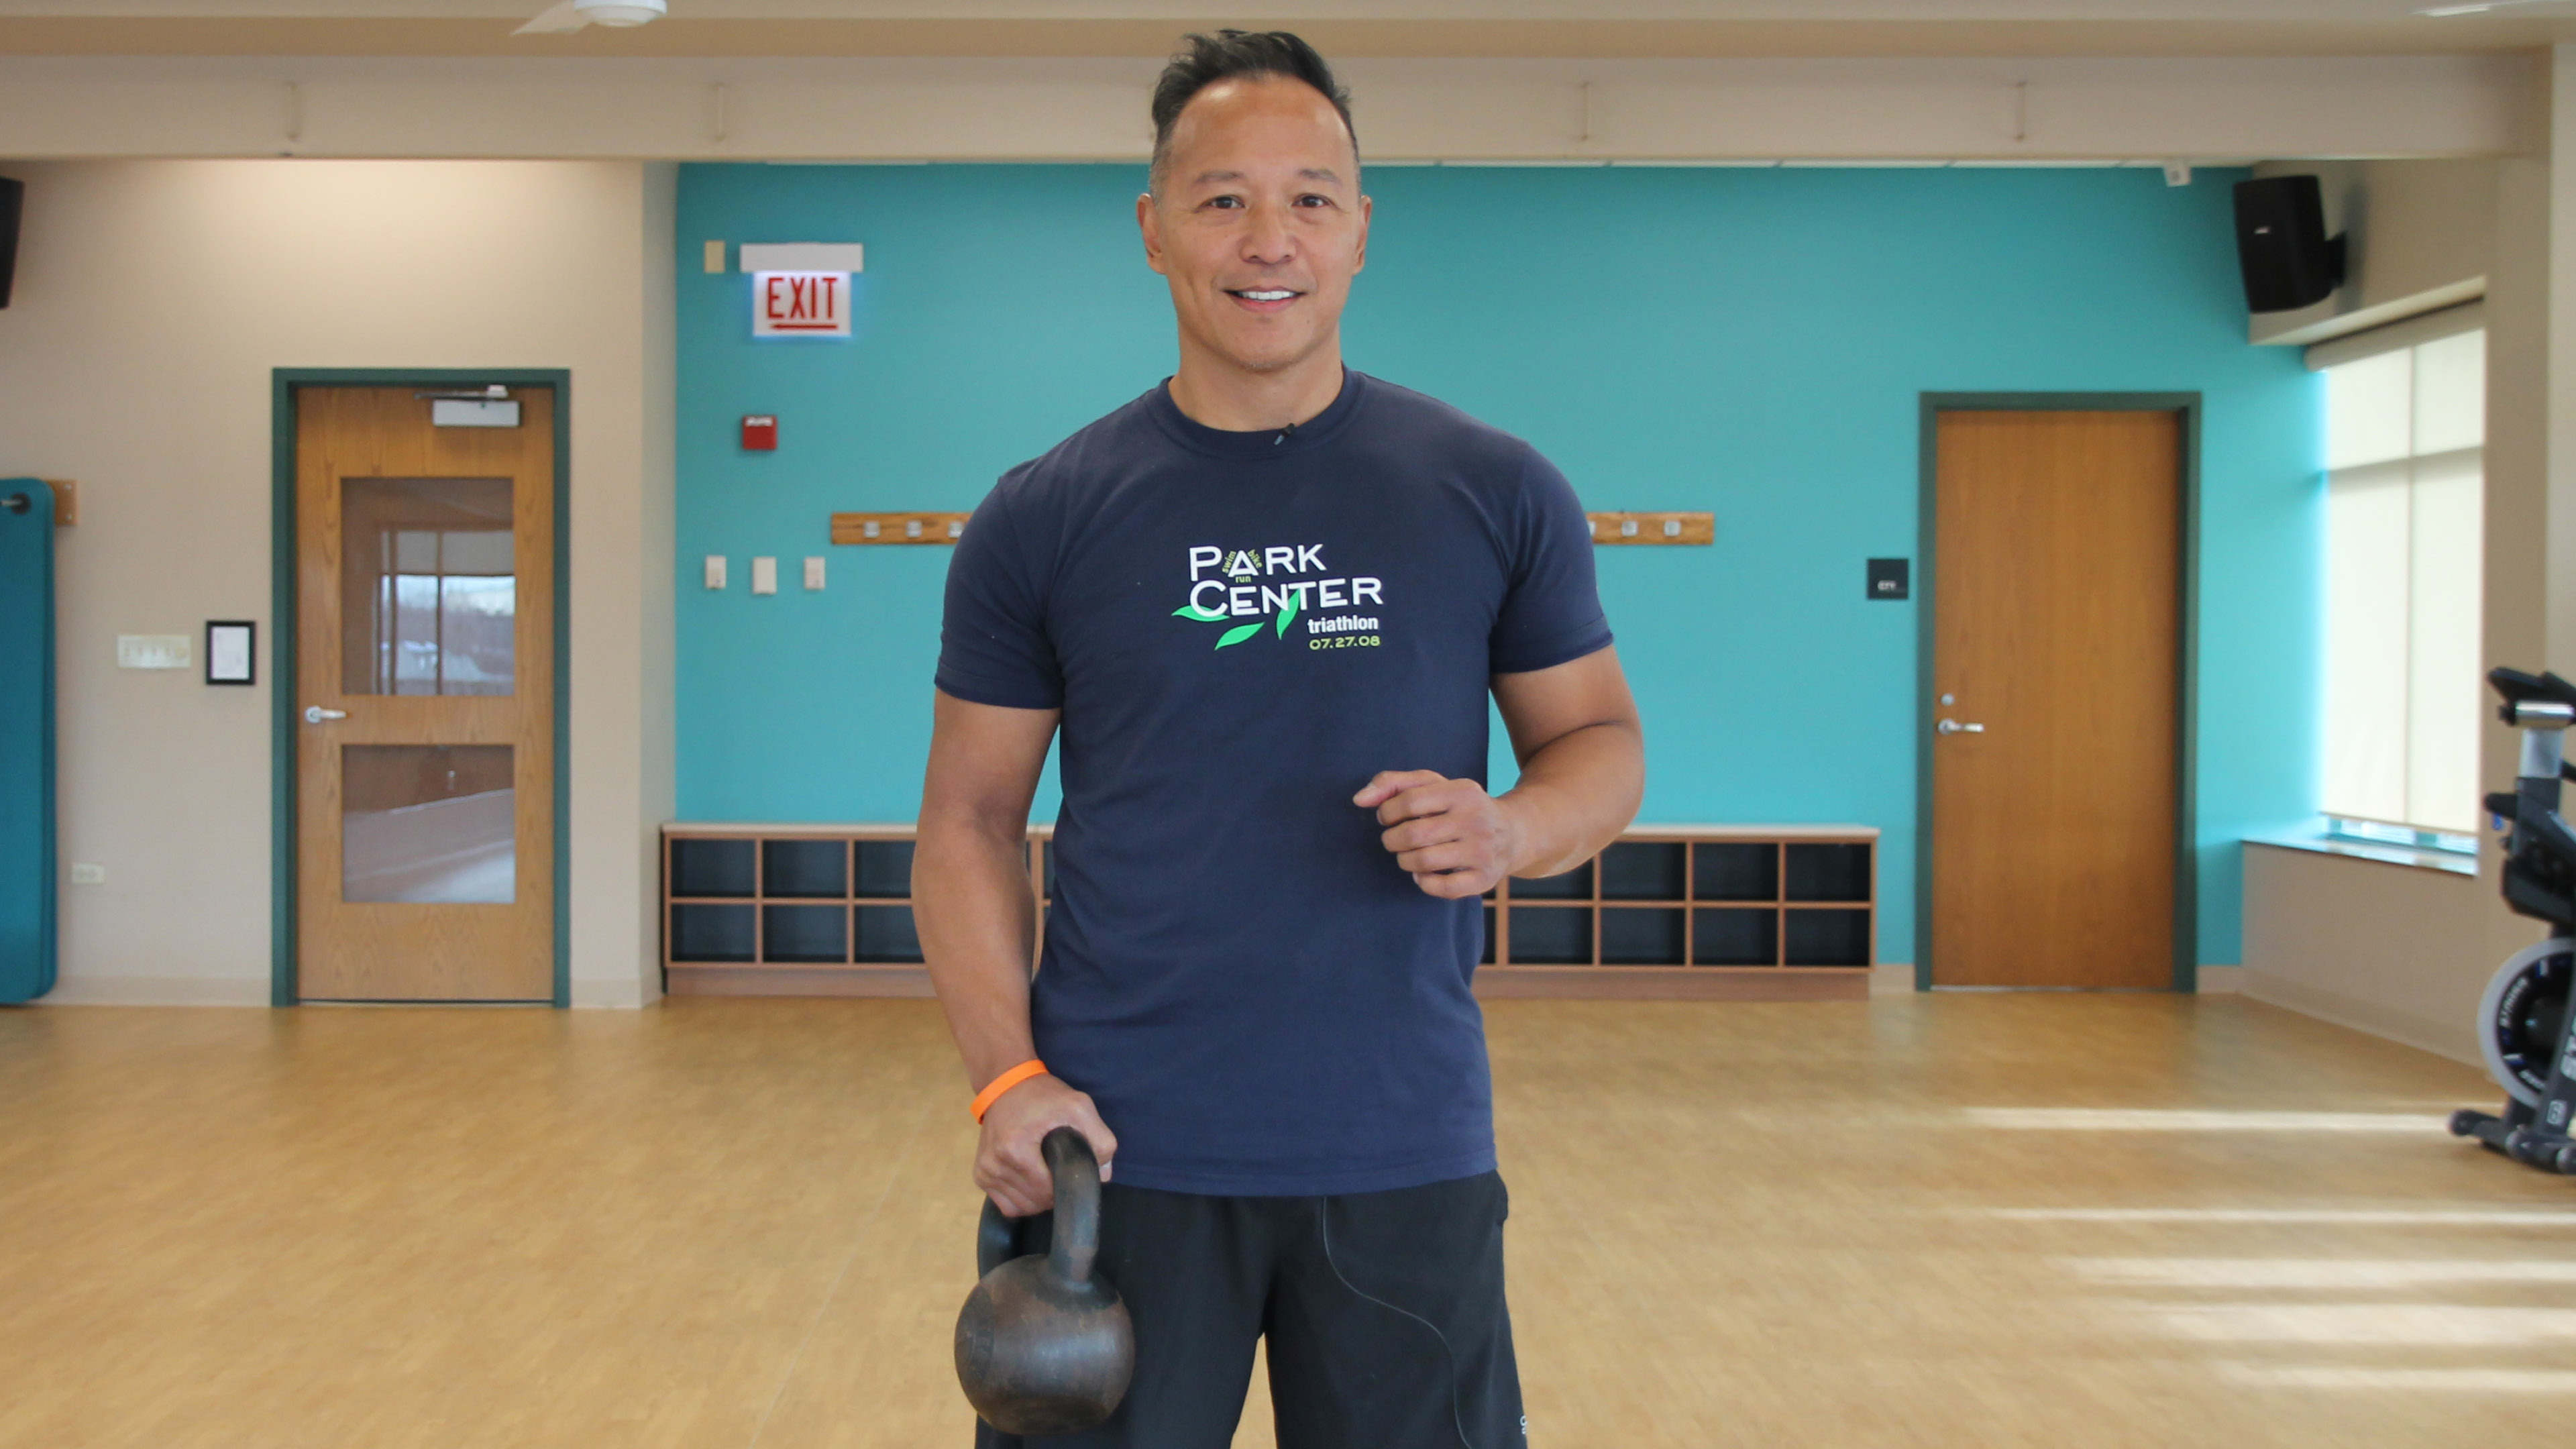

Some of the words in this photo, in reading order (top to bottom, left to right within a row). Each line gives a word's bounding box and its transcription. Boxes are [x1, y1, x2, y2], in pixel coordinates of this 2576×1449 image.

[767, 276, 838, 319] EXIT
[1189, 544, 1327, 582] PARK
[1222, 551, 1236, 574] swim
[1248, 549, 1263, 569] bike
[1189, 577, 1383, 616] CENTER
[1307, 615, 1379, 634] triathlon
[1309, 635, 1381, 650] 07.27.08
